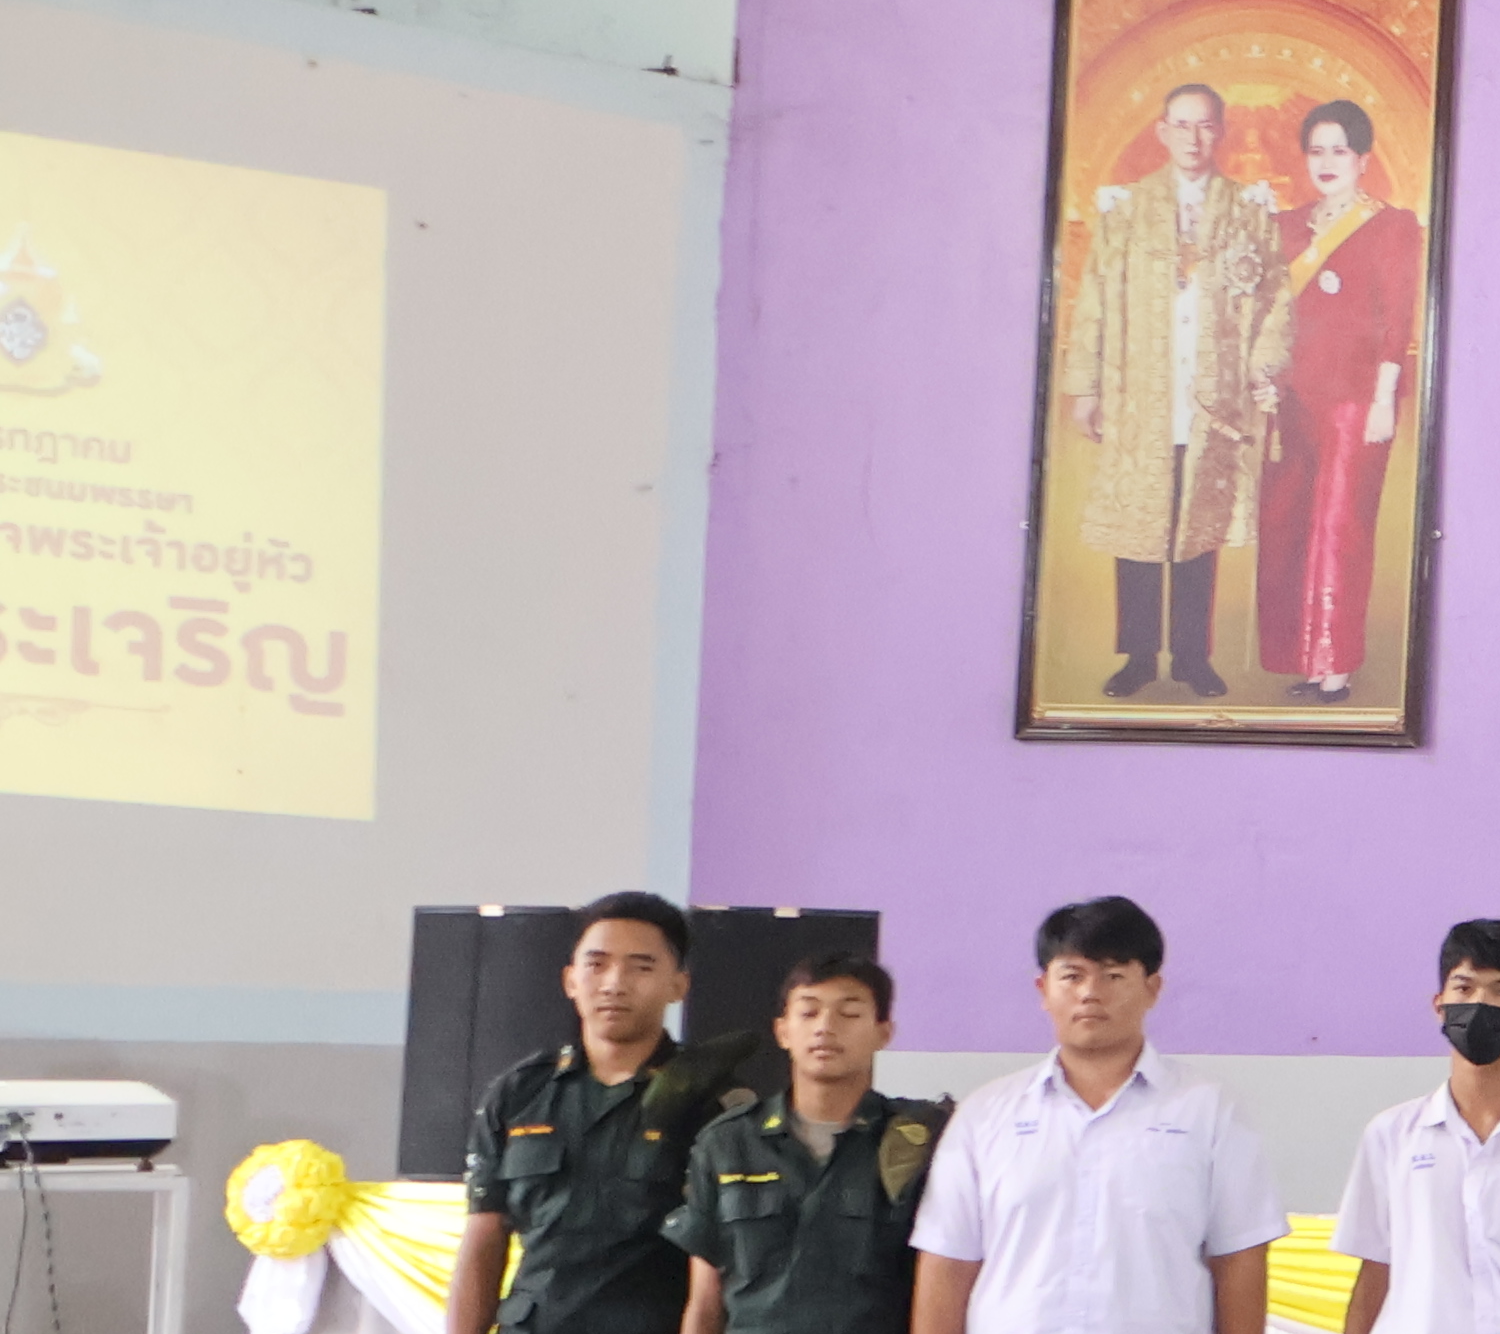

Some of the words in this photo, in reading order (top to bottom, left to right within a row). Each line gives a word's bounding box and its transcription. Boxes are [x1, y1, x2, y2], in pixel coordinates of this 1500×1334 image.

[0, 426, 132, 464] กฎาคม
[0, 595, 348, 718] ะเจริญ
